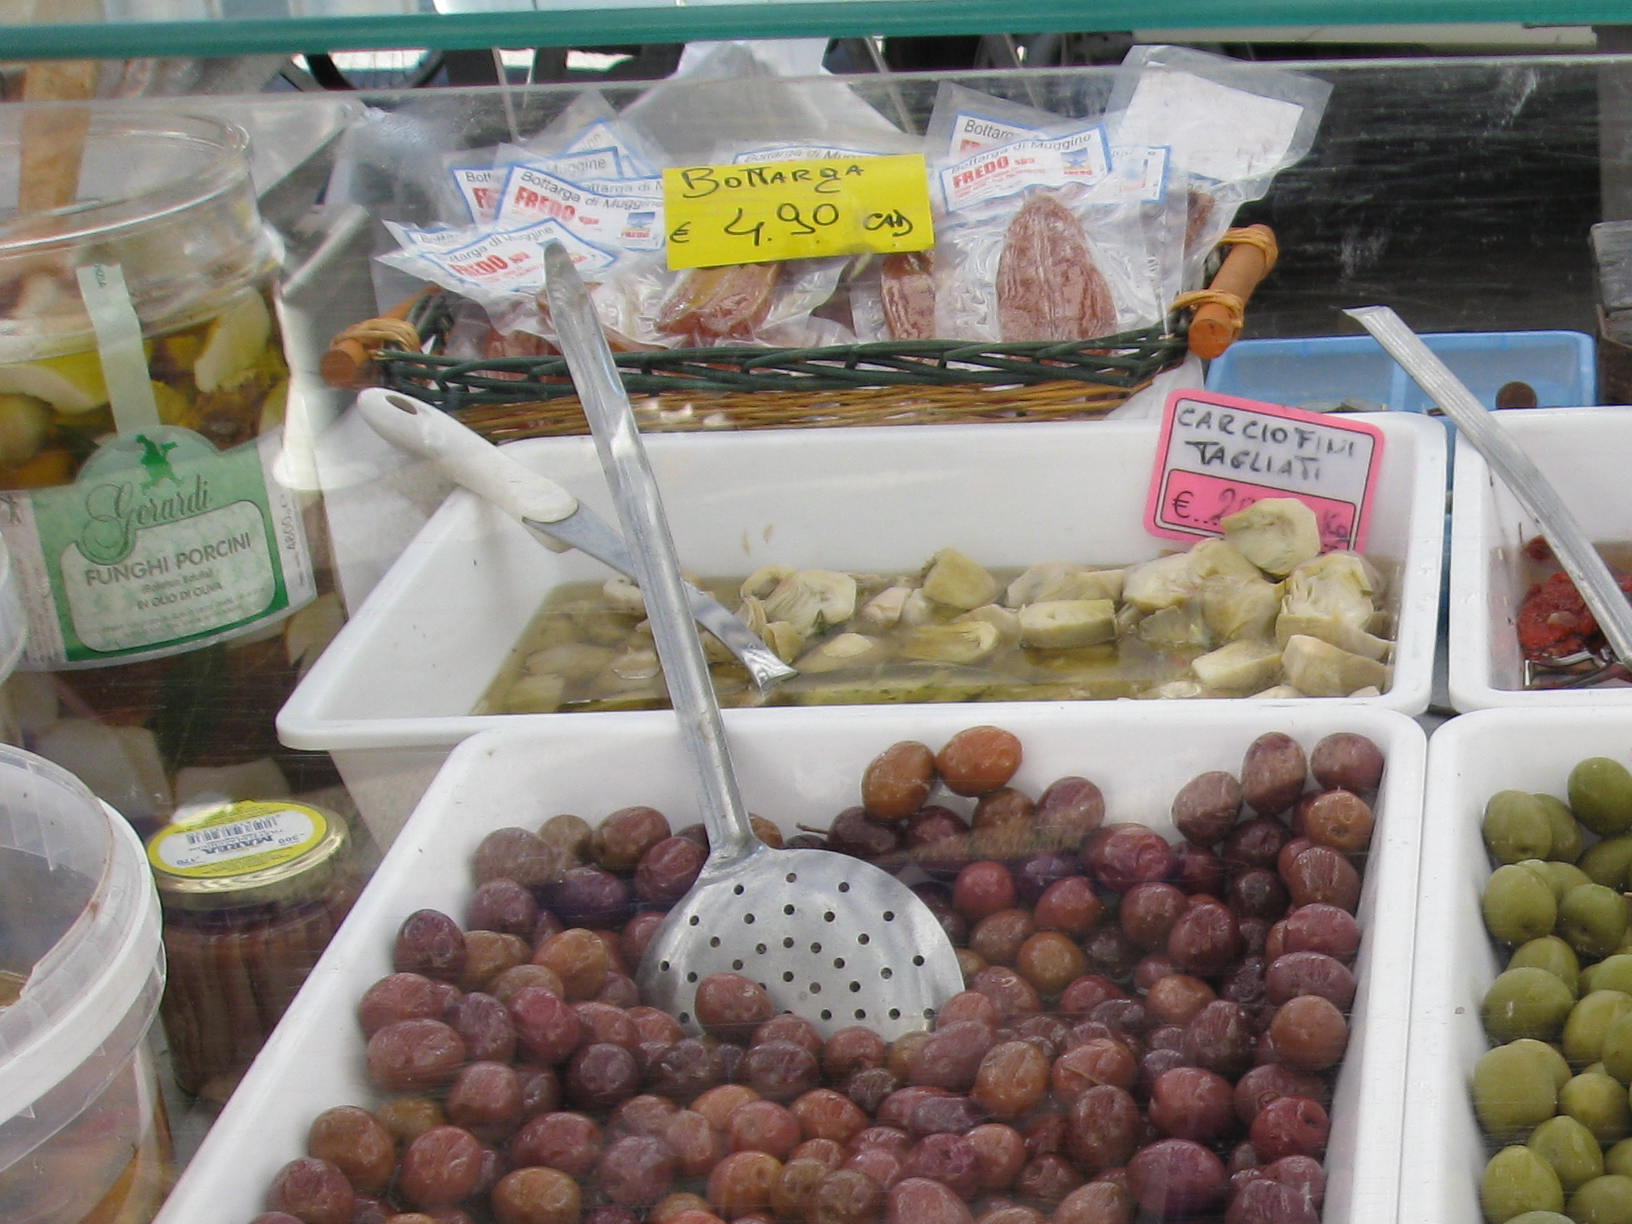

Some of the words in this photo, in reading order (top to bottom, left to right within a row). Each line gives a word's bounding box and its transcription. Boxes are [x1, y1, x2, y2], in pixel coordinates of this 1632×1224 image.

[519, 170, 581, 203] Bottarga
[585, 197, 600, 206] di
[952, 155, 1010, 188] FREDO
[669, 221, 692, 244] €
[723, 203, 840, 247] 4.90
[1184, 440, 1321, 481] TAGLIATI
[1172, 490, 1195, 519] €
[86, 556, 170, 587] FUNGHI
[175, 532, 252, 571] PORCINI
